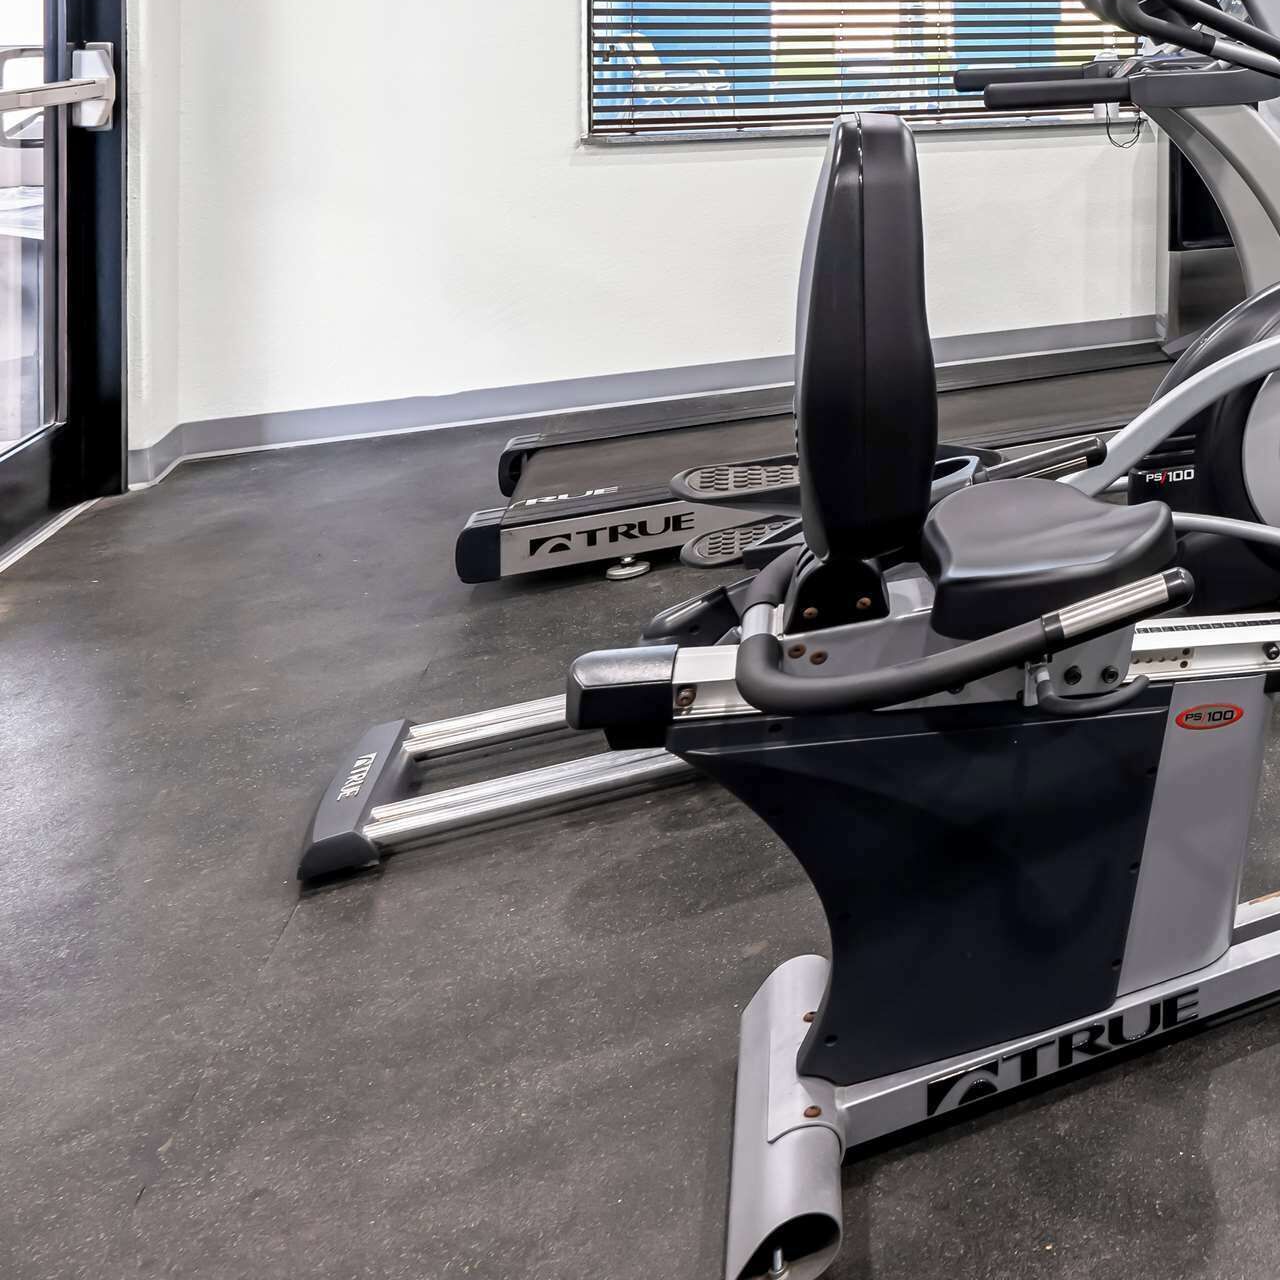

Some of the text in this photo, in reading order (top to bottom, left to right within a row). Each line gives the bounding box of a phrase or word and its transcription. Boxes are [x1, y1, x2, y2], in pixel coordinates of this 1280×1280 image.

[575, 511, 695, 547] TRUE
[336, 763, 371, 801] TRUE
[1001, 988, 1200, 1083] TRUE
